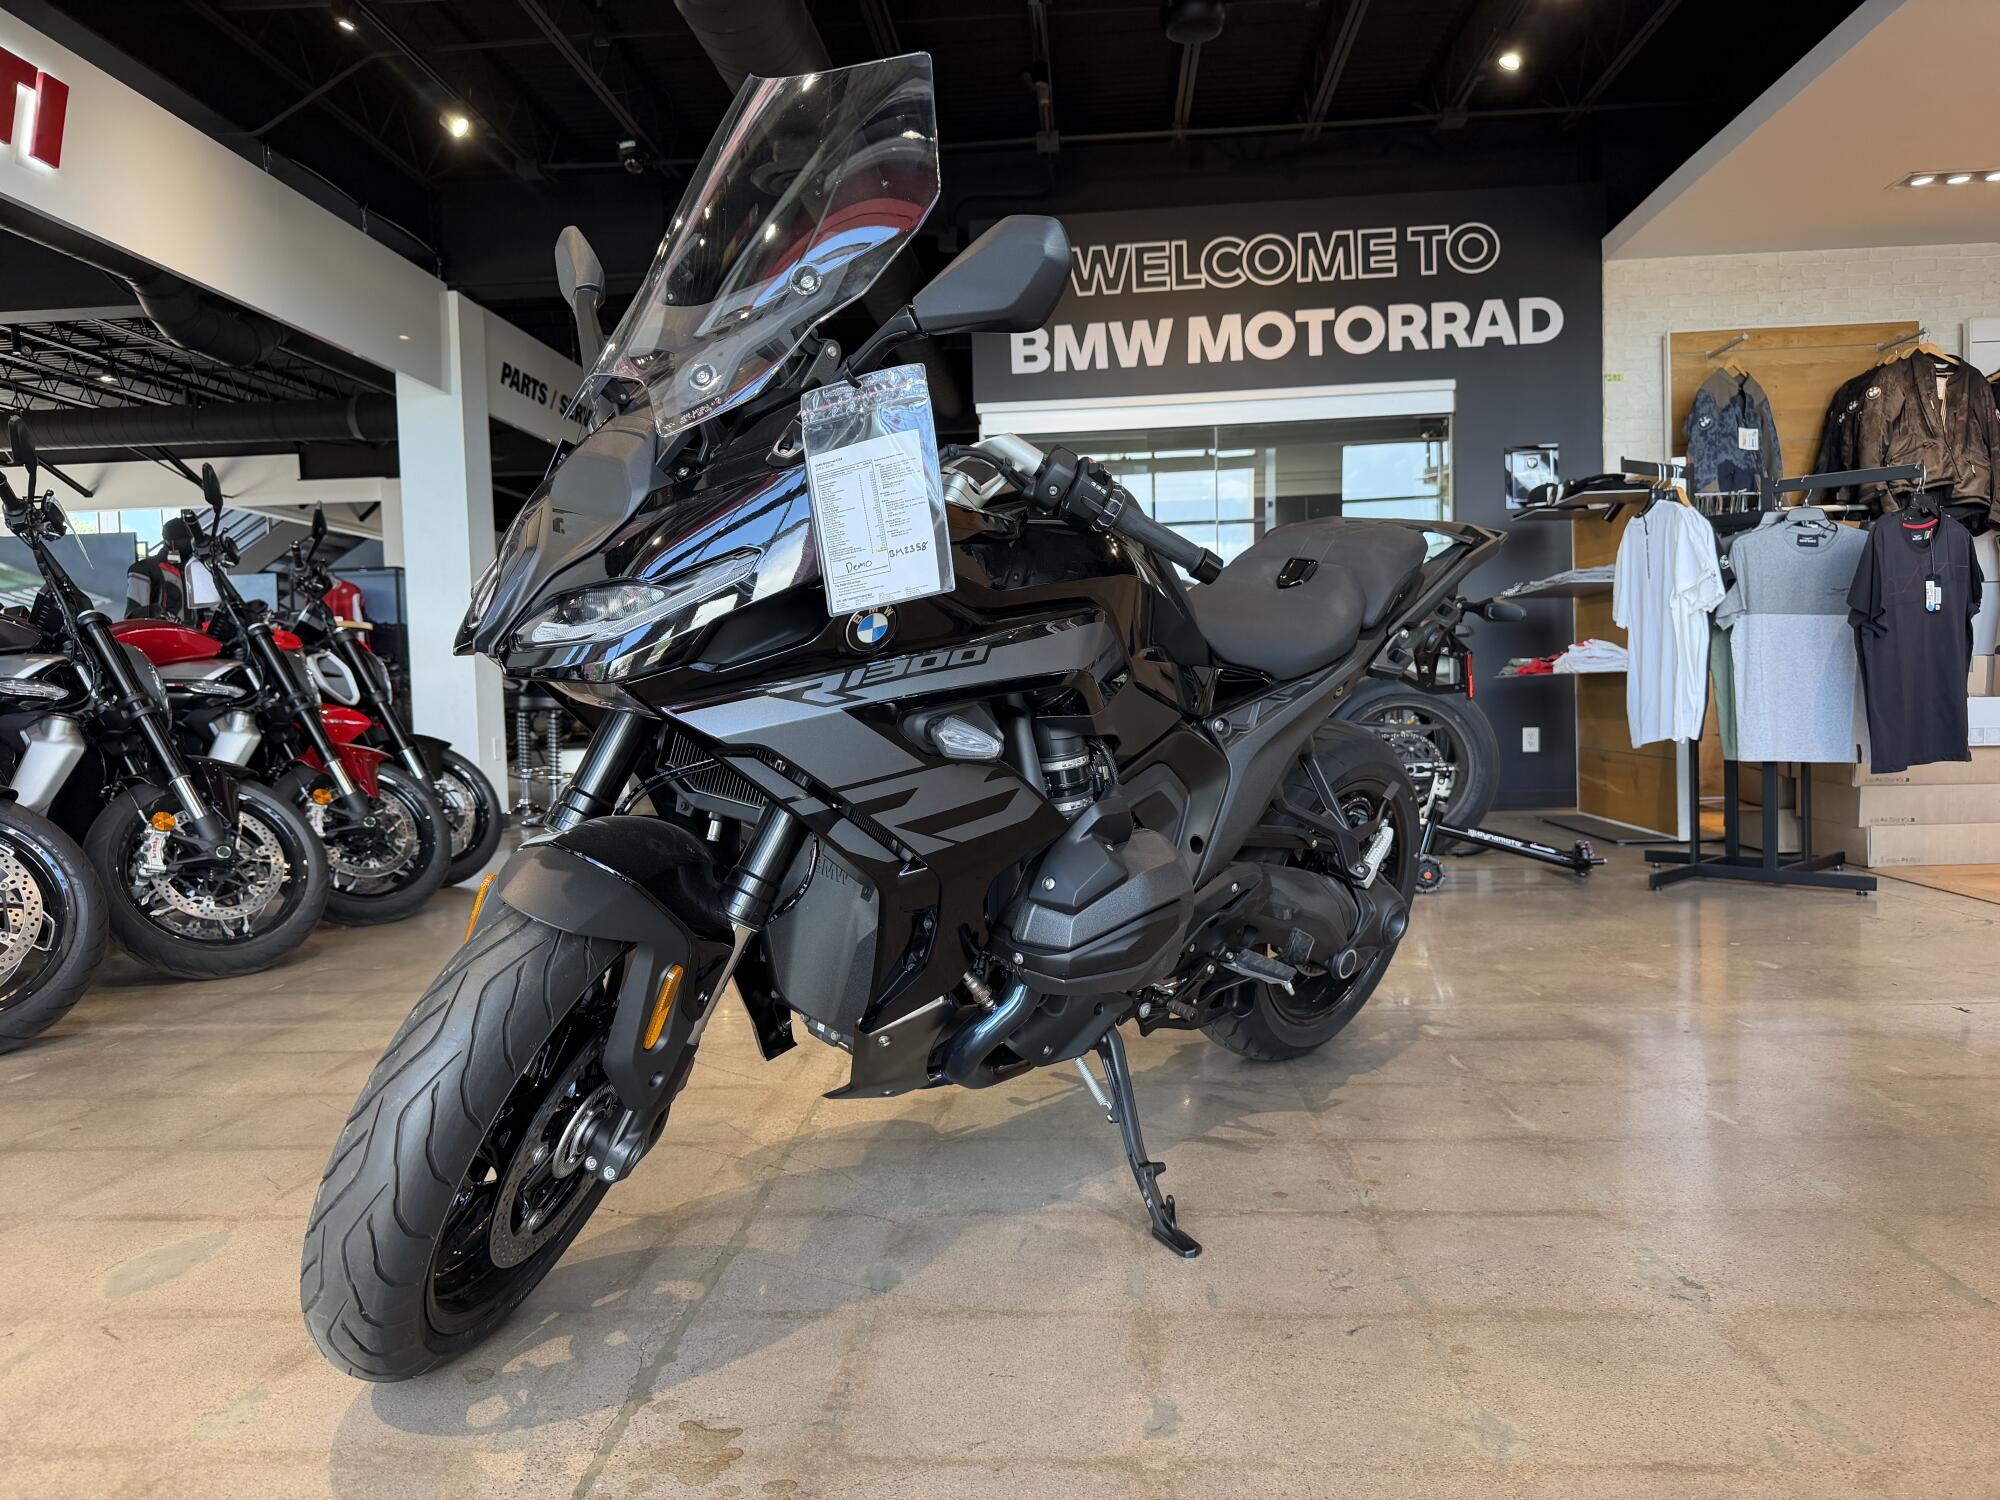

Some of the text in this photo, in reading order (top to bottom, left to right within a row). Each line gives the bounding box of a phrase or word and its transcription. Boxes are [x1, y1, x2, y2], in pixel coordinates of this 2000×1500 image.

[1070, 222, 1501, 297] WELCOME TO
[1010, 296, 1565, 375] BMW MOTORRAD
[500, 361, 549, 405] PARTS
[549, 389, 558, 411] /
[889, 540, 928, 558] BM2358
[852, 605, 895, 625] BMW
